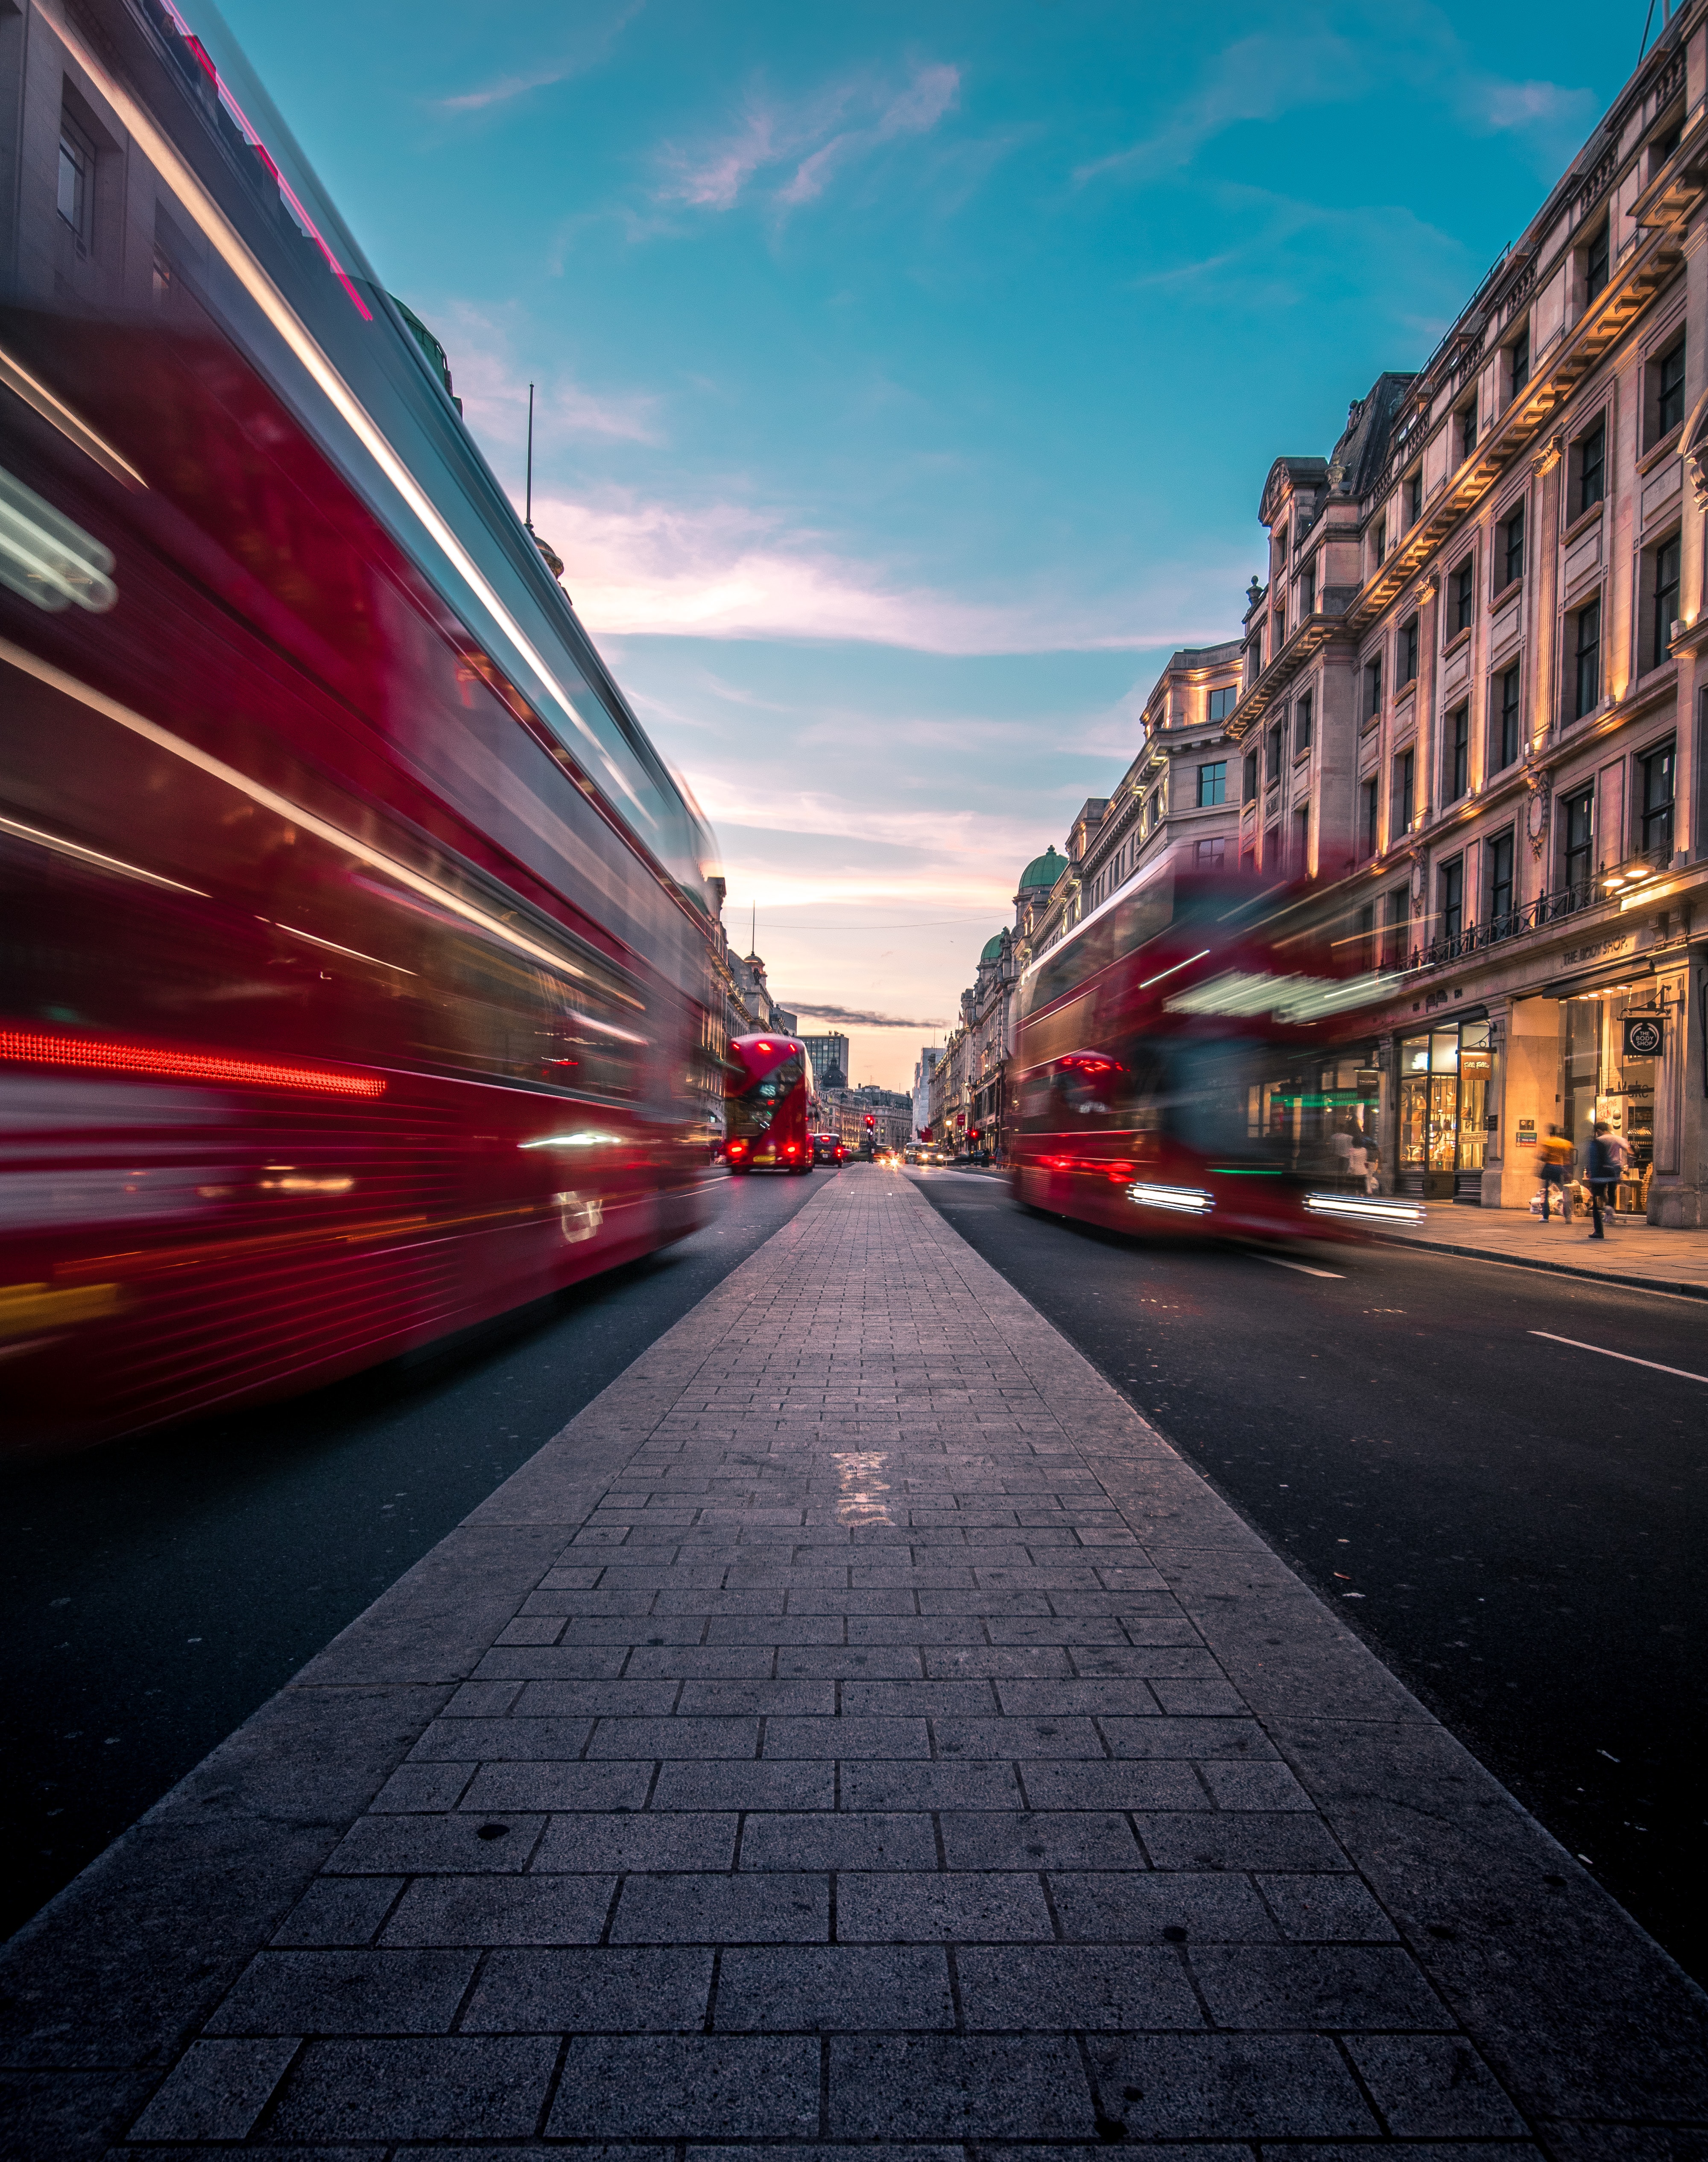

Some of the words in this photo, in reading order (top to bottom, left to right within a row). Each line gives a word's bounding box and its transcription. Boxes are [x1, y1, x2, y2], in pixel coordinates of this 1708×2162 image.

[1563, 950, 1579, 966] THE
[1579, 942, 1602, 961] BODY
[1464, 1062, 1475, 1070] Folli
[1476, 1061, 1490, 1069] Follie
[1597, 1098, 1617, 1112] SENSITIVE
[1600, 1108, 1611, 1120] SKIN
